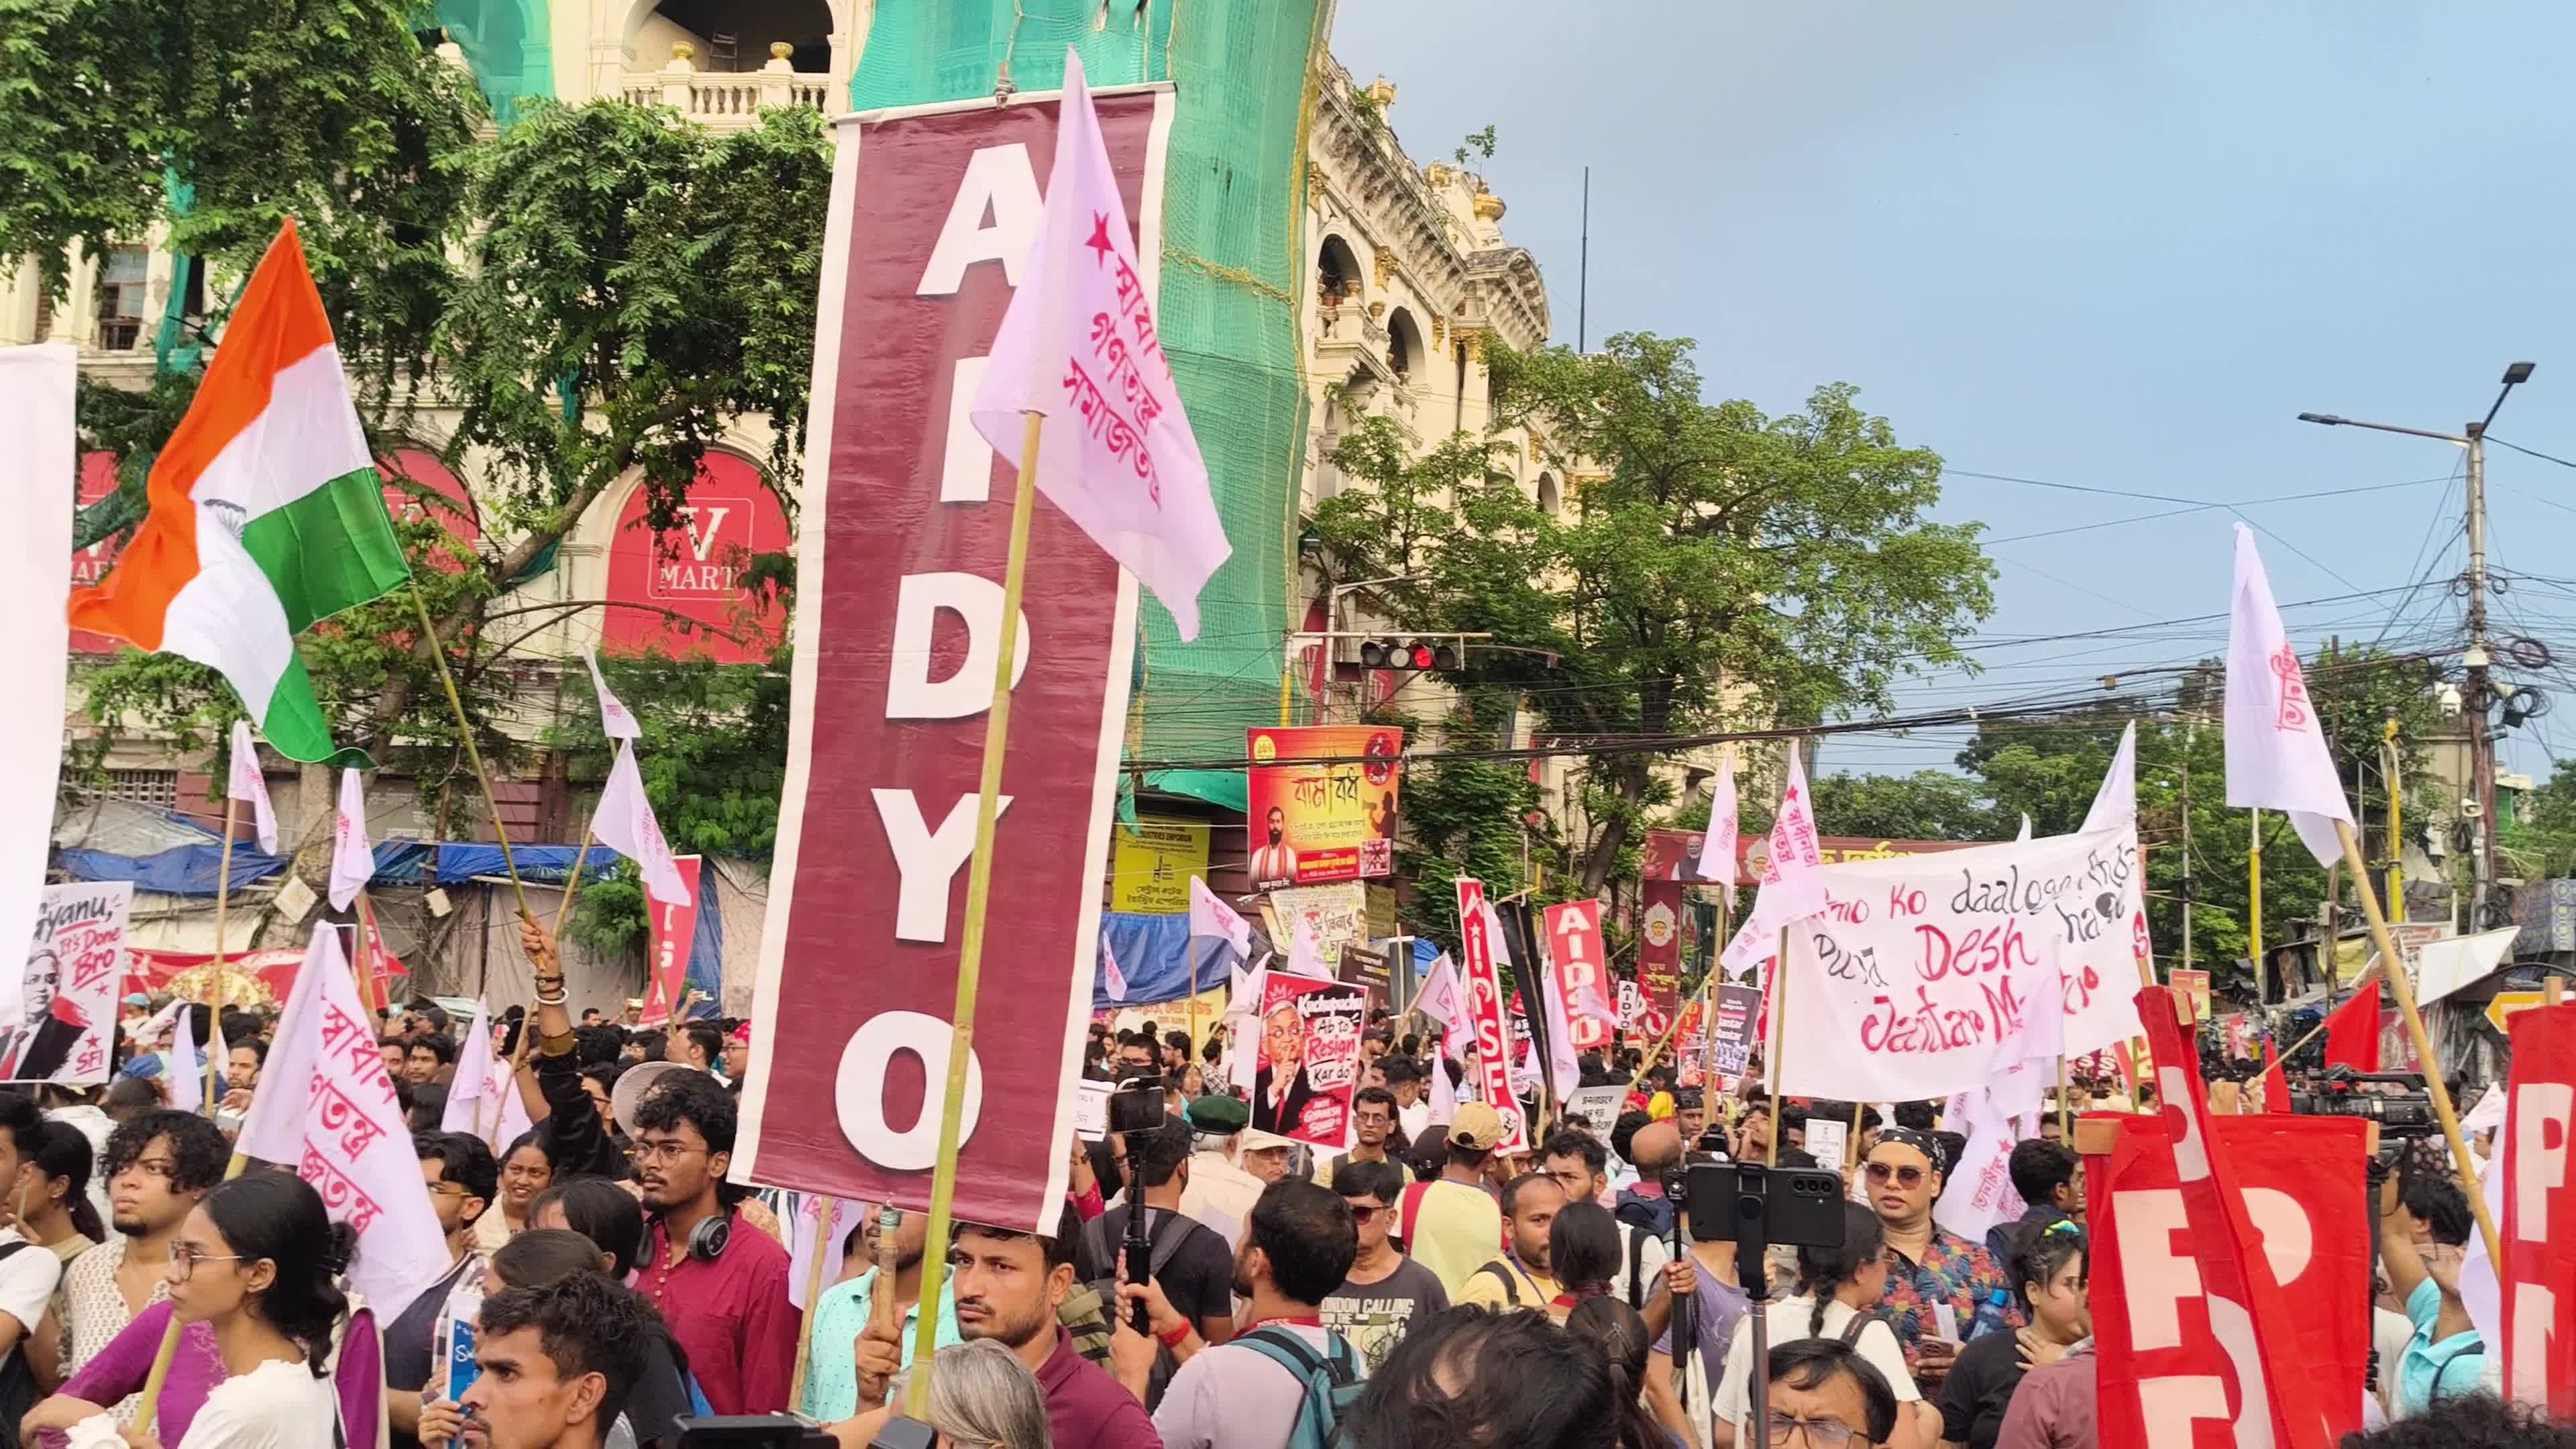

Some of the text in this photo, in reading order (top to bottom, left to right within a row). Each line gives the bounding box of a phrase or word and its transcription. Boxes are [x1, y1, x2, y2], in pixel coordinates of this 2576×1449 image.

[676, 506, 731, 561] V
[658, 565, 739, 590] MART
[834, 142, 1045, 1171] AIDYO
[81, 927, 121, 953] Done
[1915, 917, 2039, 982] Desh
[71, 950, 115, 986] Bro
[1619, 984, 1633, 1029] AIDYO
[1860, 984, 1986, 1054] Jantar
[75, 1049, 105, 1071] SFI
[1308, 1035, 1356, 1063] Resign
[1313, 1066, 1333, 1085] Kar
[1320, 1296, 1415, 1314] ONDON CALLING
